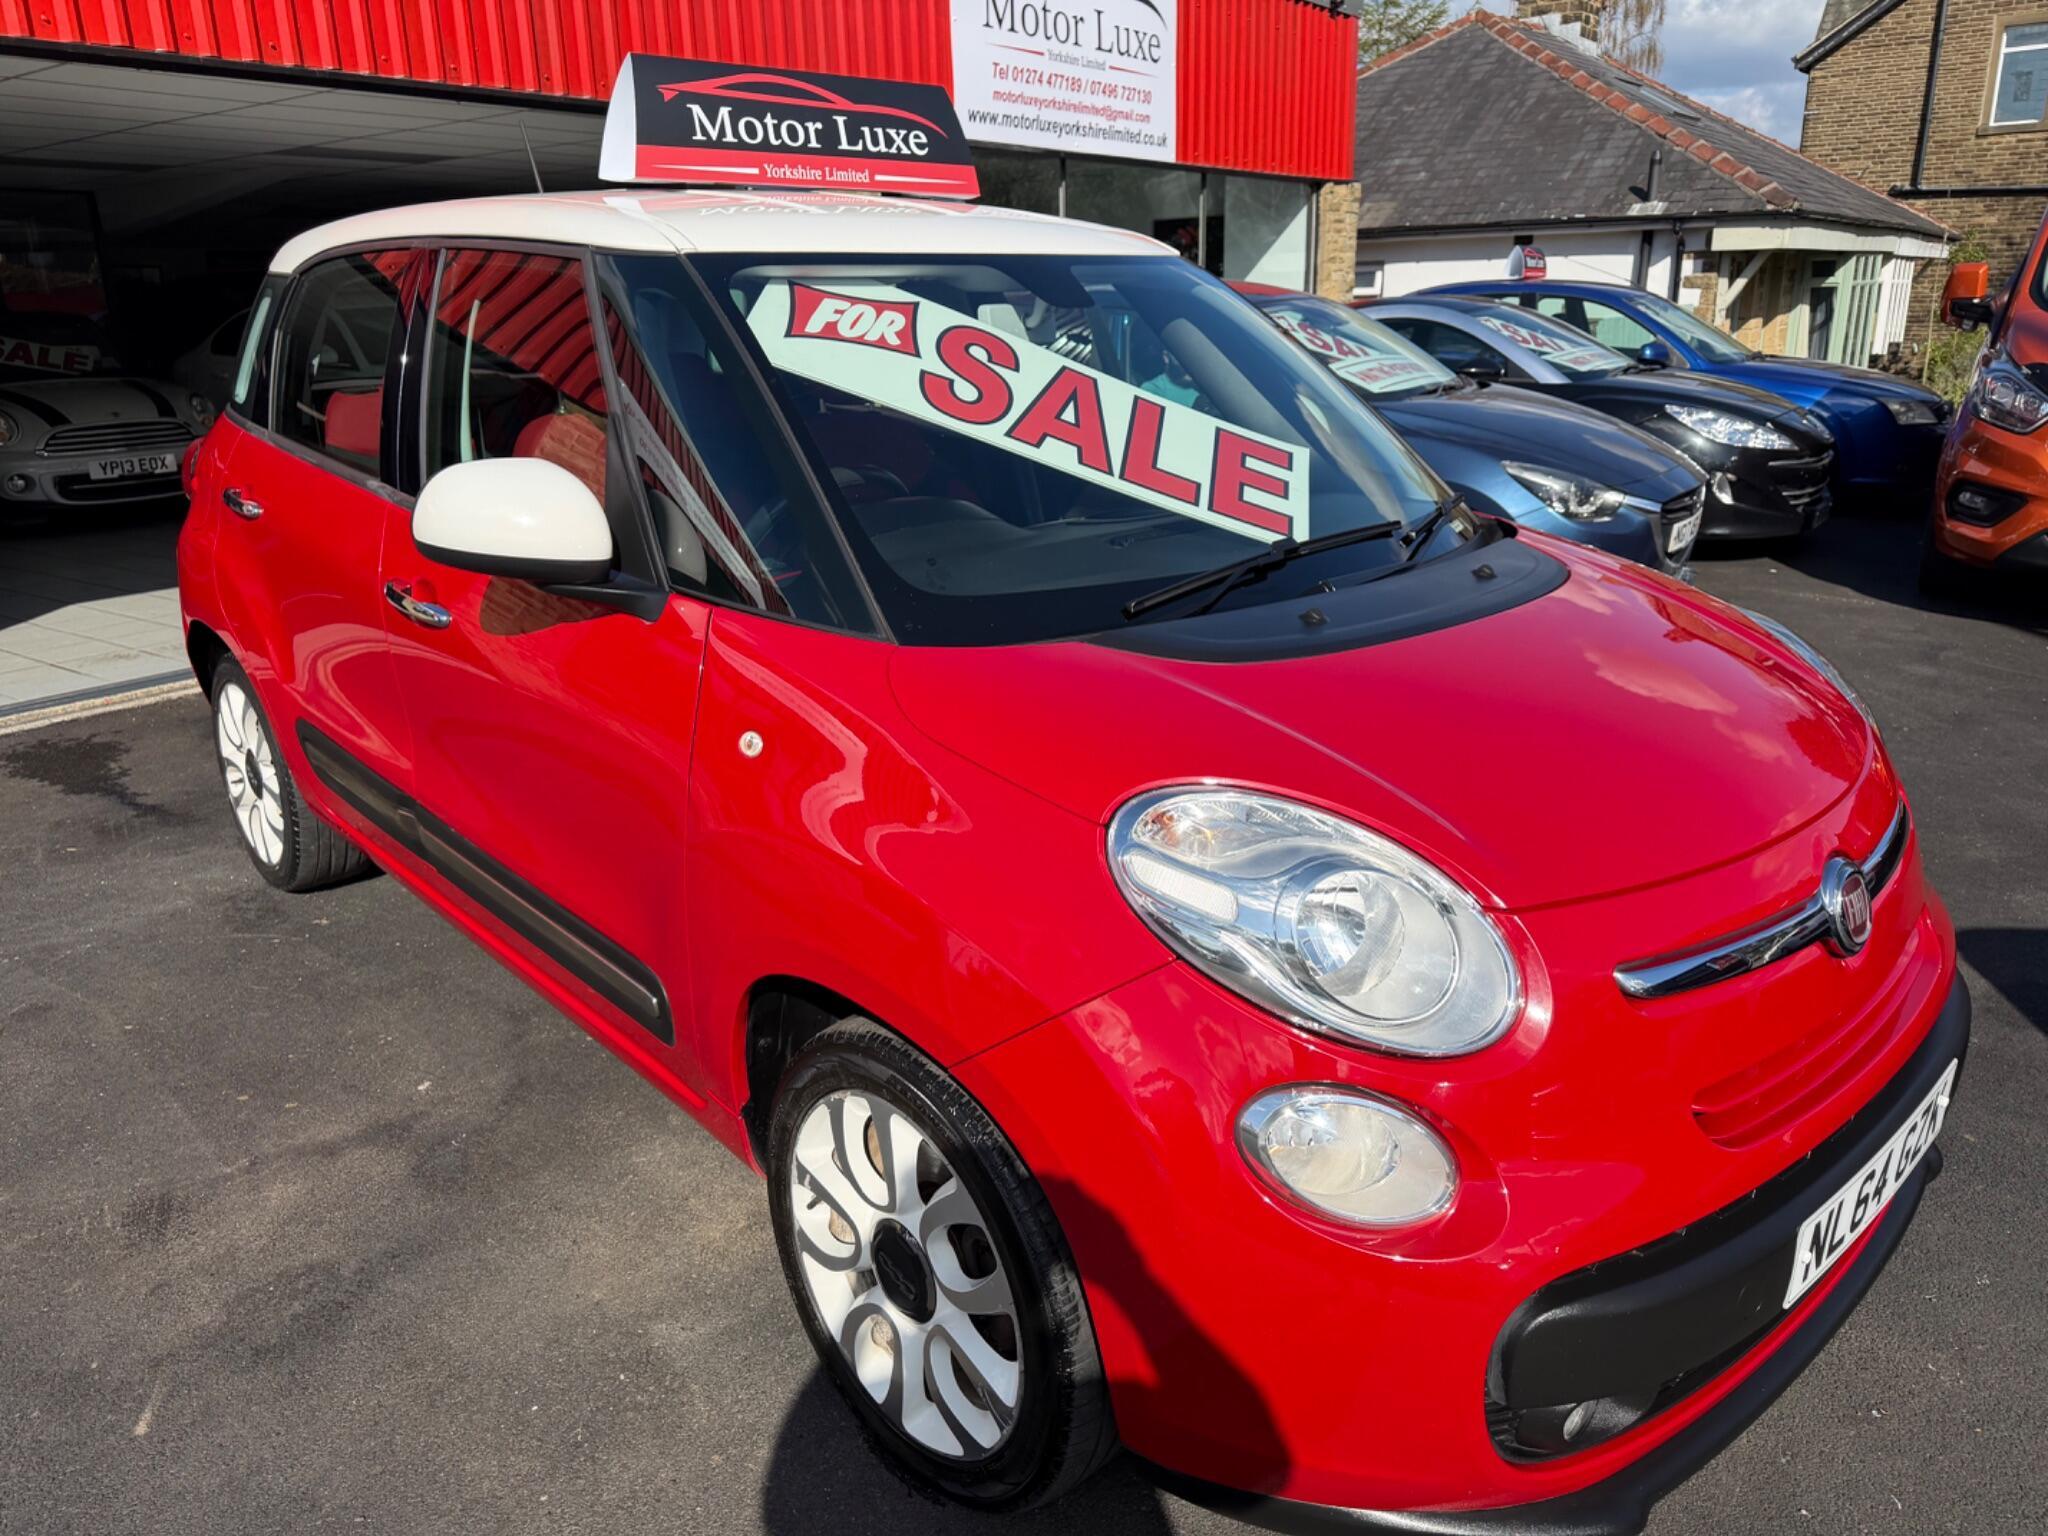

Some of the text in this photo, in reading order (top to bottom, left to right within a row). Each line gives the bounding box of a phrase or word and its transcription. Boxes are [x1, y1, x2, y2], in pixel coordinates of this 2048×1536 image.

[983, 0, 1161, 64] Motor Luxe
[992, 62, 1008, 80] Tel
[1012, 65, 1044, 87] 01274
[1046, 73, 1083, 93] 477189
[1121, 86, 1152, 104] 727130
[992, 89, 1151, 123] motorluxeyorkshirelimited@gmail.com
[686, 103, 929, 157] Motor Luxe
[968, 109, 1168, 147] www.motorluxeyorkshirelimited.co.uk
[763, 163, 870, 183] Yorkshire Limited
[804, 297, 907, 347] FOR
[0, 337, 90, 371] ALE
[919, 325, 1294, 537] SALE
[98, 455, 168, 476] YP13 EOX
